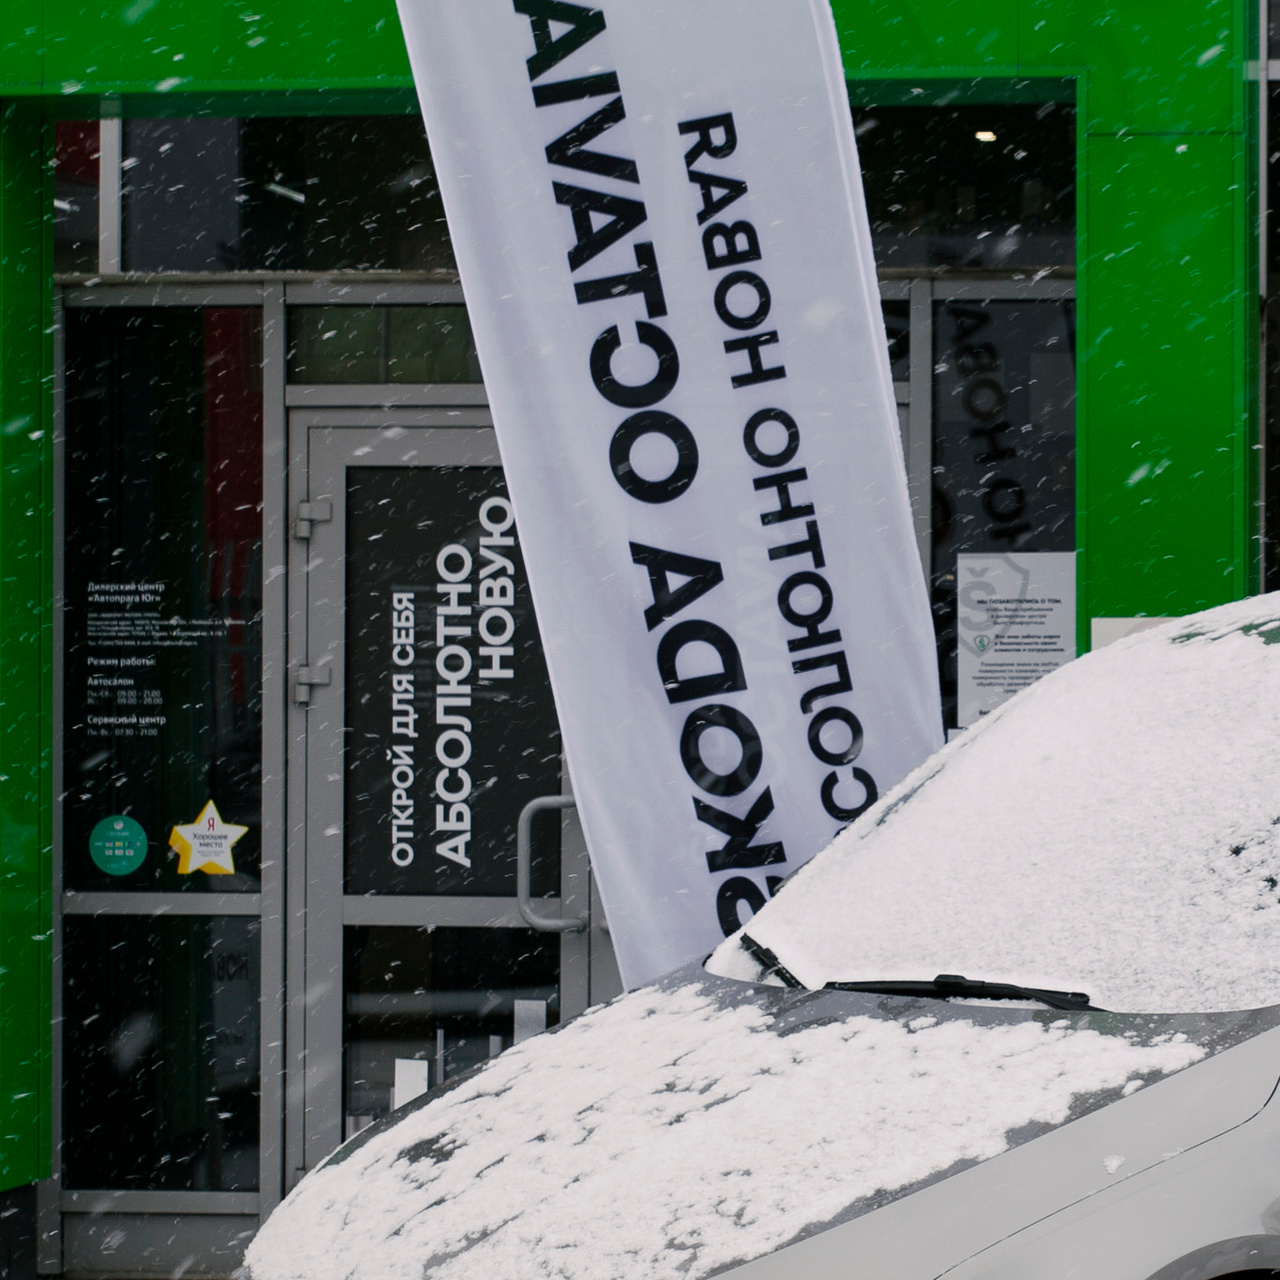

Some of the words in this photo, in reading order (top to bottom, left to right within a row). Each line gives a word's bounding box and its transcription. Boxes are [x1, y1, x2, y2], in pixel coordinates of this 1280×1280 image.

[88, 582, 136, 592] Дилерский
[138, 582, 165, 592] центр
[479, 496, 515, 679] НОВУЮ
[392, 592, 415, 666] СЕБЯ
[87, 677, 134, 685] Автосалон
[392, 674, 419, 738] ДЛЯ
[436, 543, 472, 869] АБСОЛЮТНО
[192, 832, 228, 841] Хорошее
[207, 817, 215, 832] Я
[385, 743, 414, 868] ОТКРОЙ
